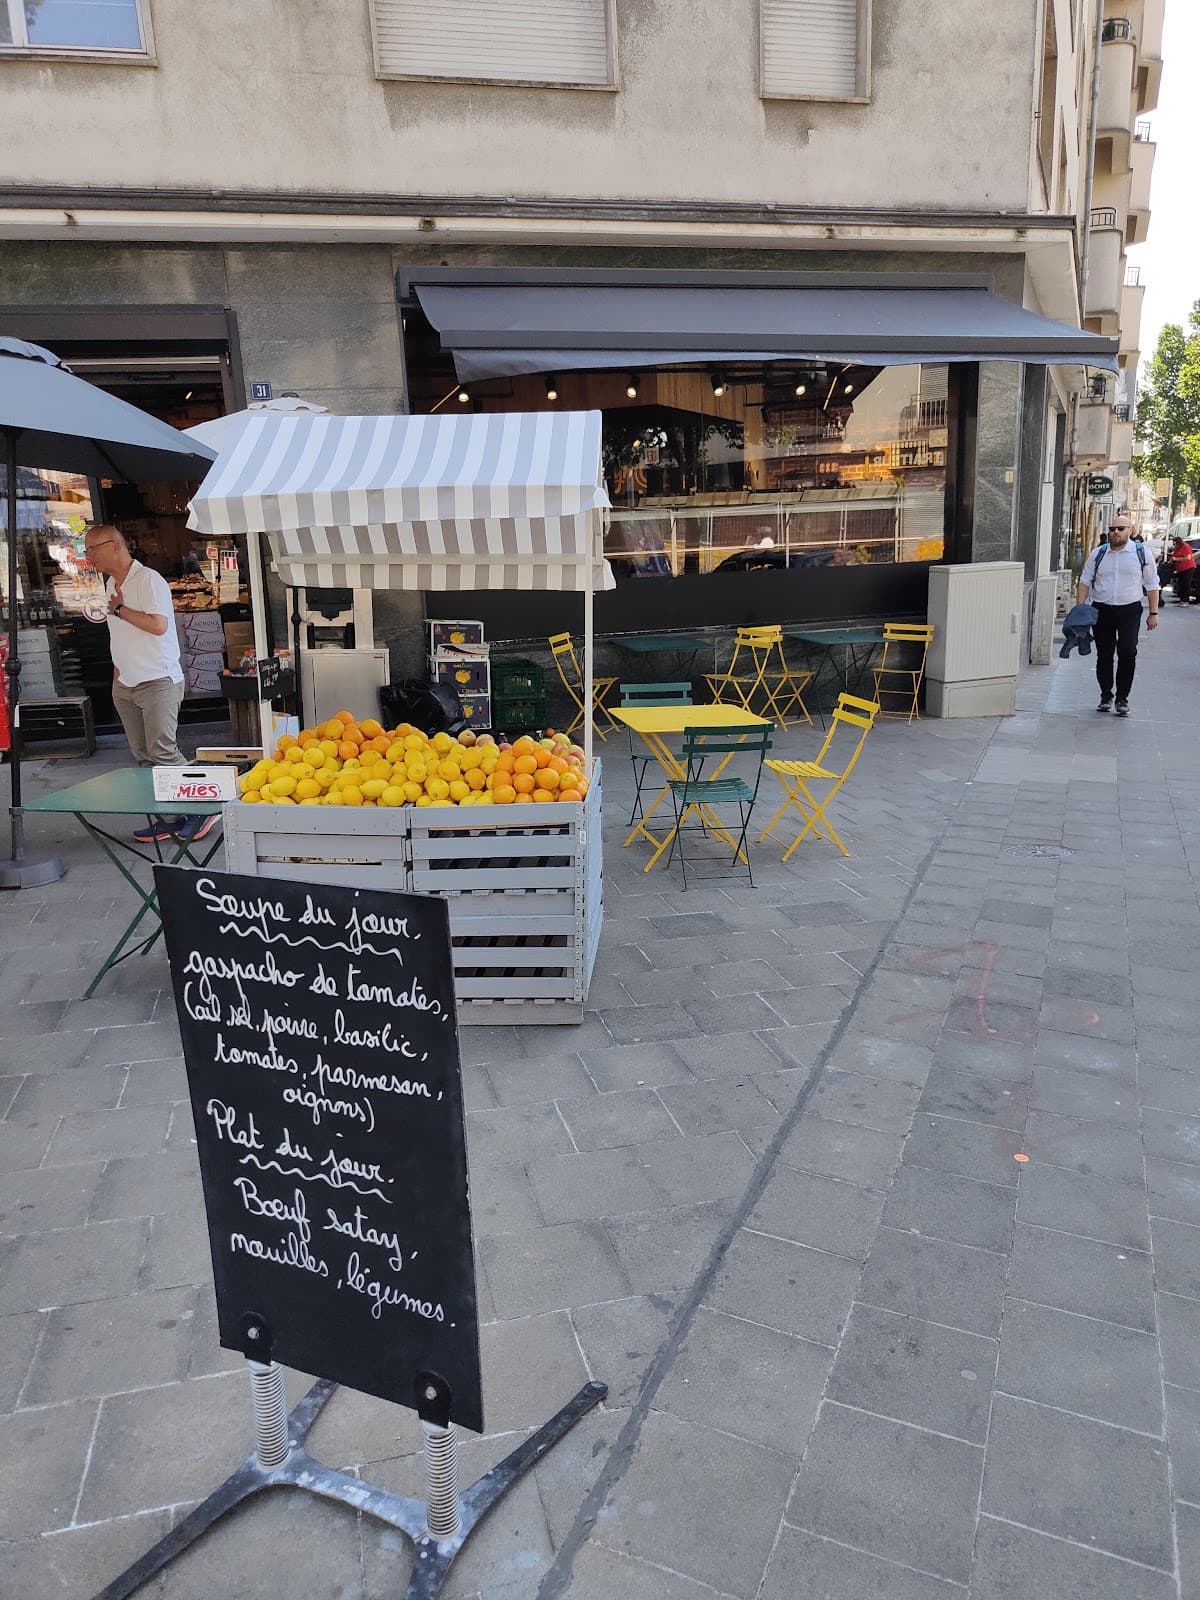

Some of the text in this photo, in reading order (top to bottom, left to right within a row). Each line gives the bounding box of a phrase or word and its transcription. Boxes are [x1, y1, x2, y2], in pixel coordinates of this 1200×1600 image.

[256, 384, 267, 397] 31
[196, 878, 291, 941] Soupe
[298, 895, 336, 926] du
[183, 950, 305, 1002] gaspacho
[309, 963, 339, 997] de
[207, 1098, 264, 1149] Plat
[276, 1127, 313, 1162] du
[283, 1084, 375, 1132] oignons)
